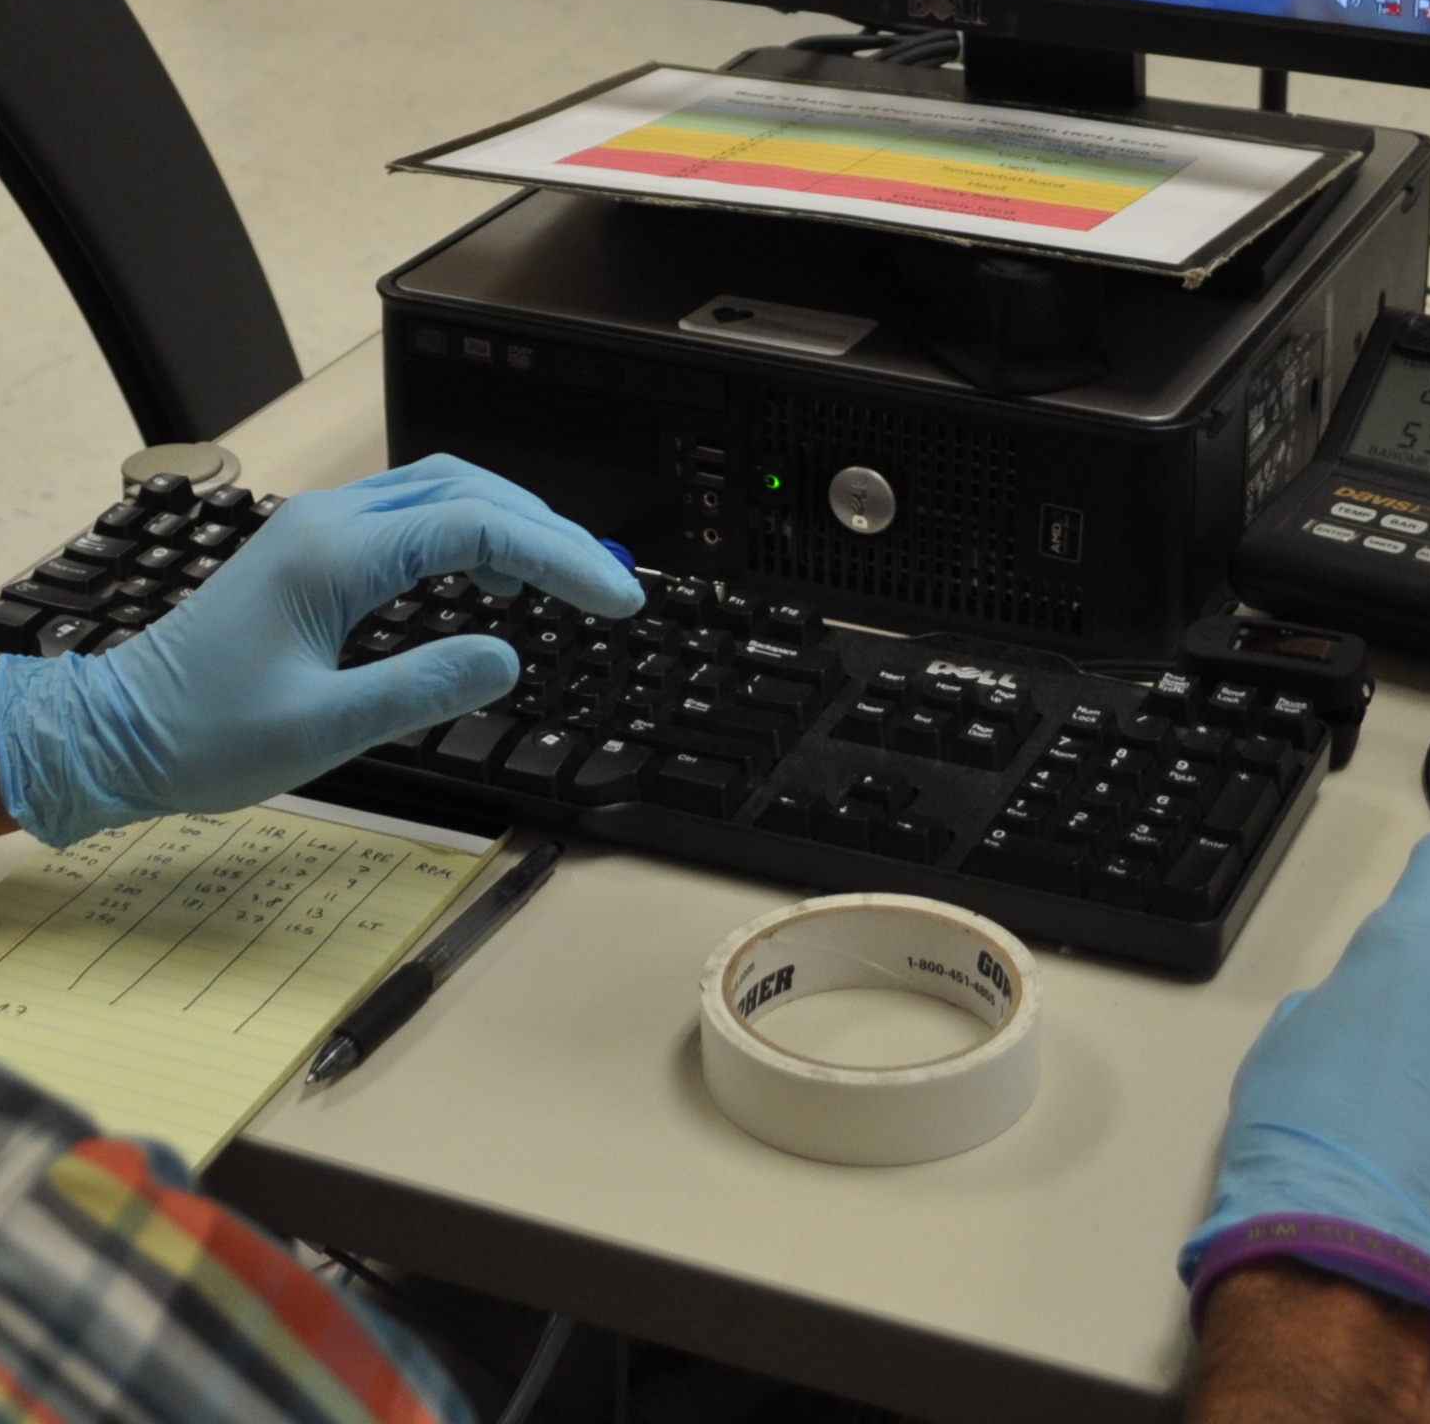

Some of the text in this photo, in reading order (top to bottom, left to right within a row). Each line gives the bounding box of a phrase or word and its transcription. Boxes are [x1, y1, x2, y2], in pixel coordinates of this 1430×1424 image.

[1337, 505, 1371, 519] TEMP
[1389, 518, 1417, 531] BAR
[677, 584, 696, 597] F10
[729, 595, 746, 607] F11
[926, 659, 1017, 690] DELL
[935, 681, 962, 693] Home
[995, 688, 1017, 700] Page
[1216, 693, 1241, 704] Lock
[1076, 705, 1101, 717] Num
[913, 713, 933, 724] End
[1072, 712, 1098, 724] Lock
[257, 825, 287, 840] HR
[360, 847, 396, 864] RPE
[416, 861, 454, 879] RPM
[736, 963, 795, 1020] PHER
